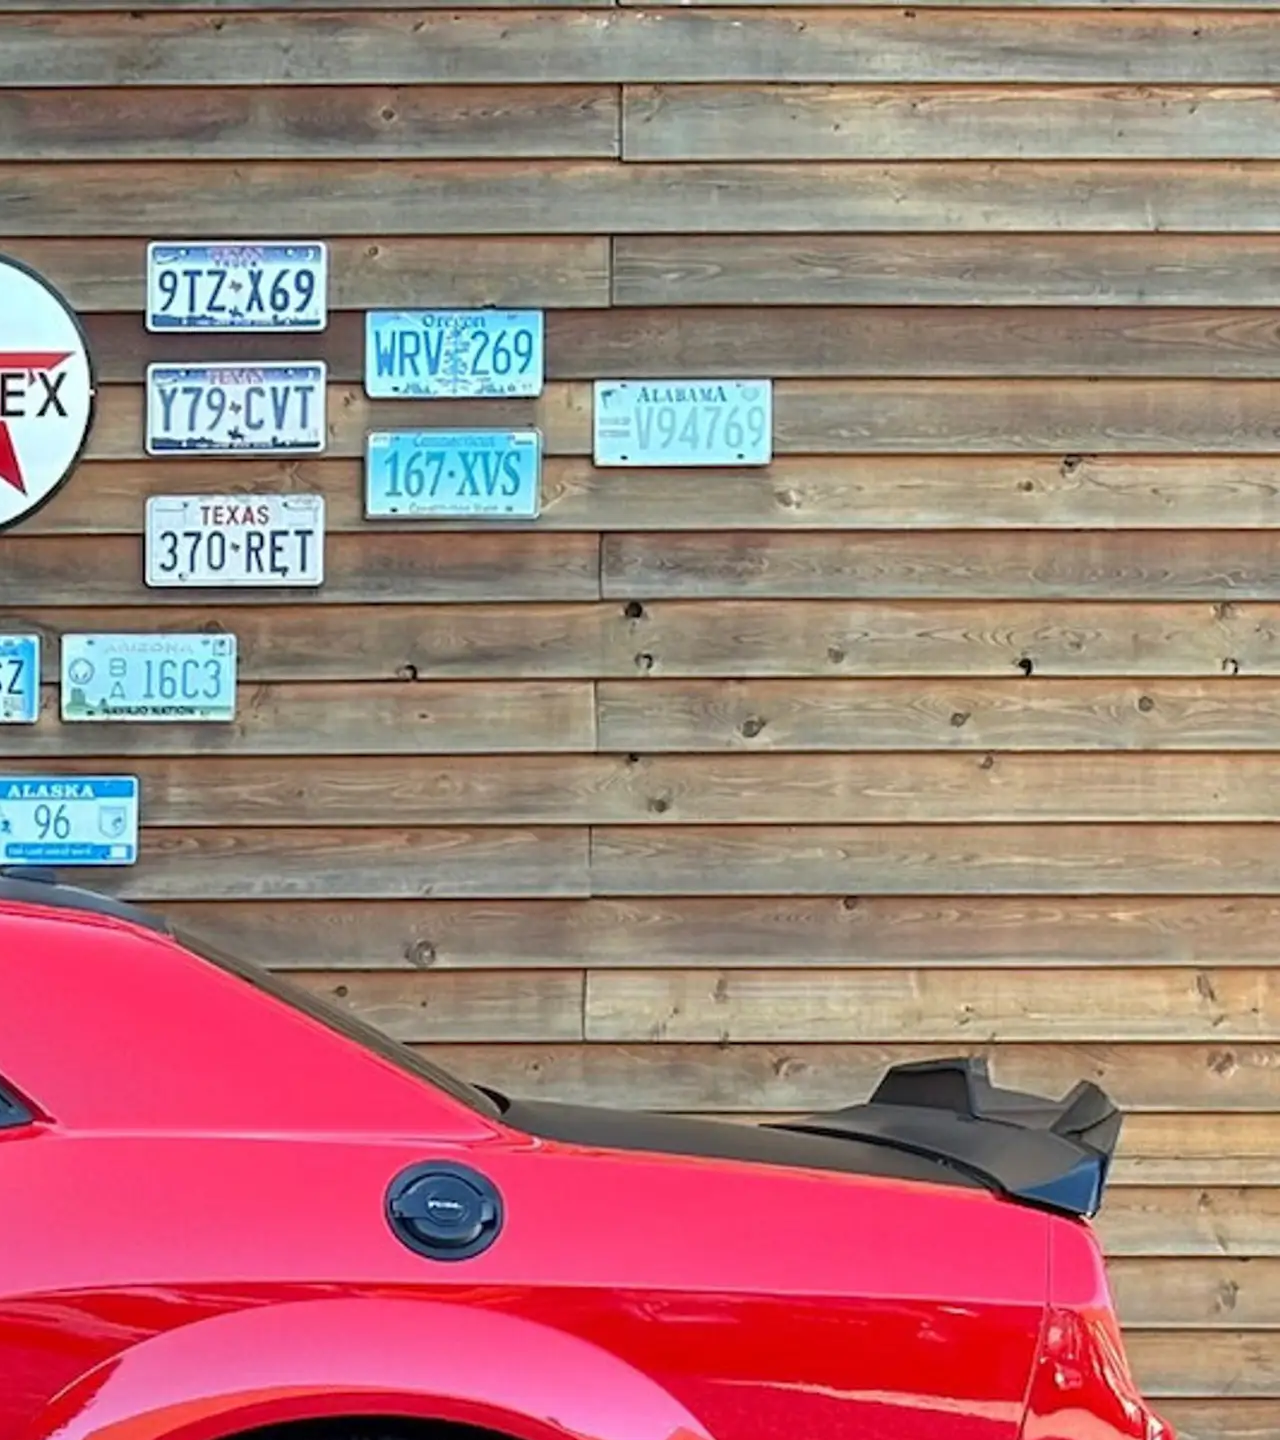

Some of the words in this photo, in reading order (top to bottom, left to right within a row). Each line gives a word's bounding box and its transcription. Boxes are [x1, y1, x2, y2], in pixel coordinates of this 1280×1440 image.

[158, 269, 227, 312] 9TZ
[246, 269, 315, 312] X69
[421, 315, 486, 329] Oregon
[375, 330, 444, 377] WRV
[470, 329, 533, 375] 269
[158, 387, 226, 431] Y79
[244, 386, 315, 430] CVT
[633, 405, 765, 450] V94769
[200, 505, 270, 525] TEXAS
[160, 530, 226, 572] 370
[246, 530, 314, 573] RET
[151, 706, 195, 715] NATION
[8, 784, 95, 798] ALASKA
[34, 804, 71, 840] 96
